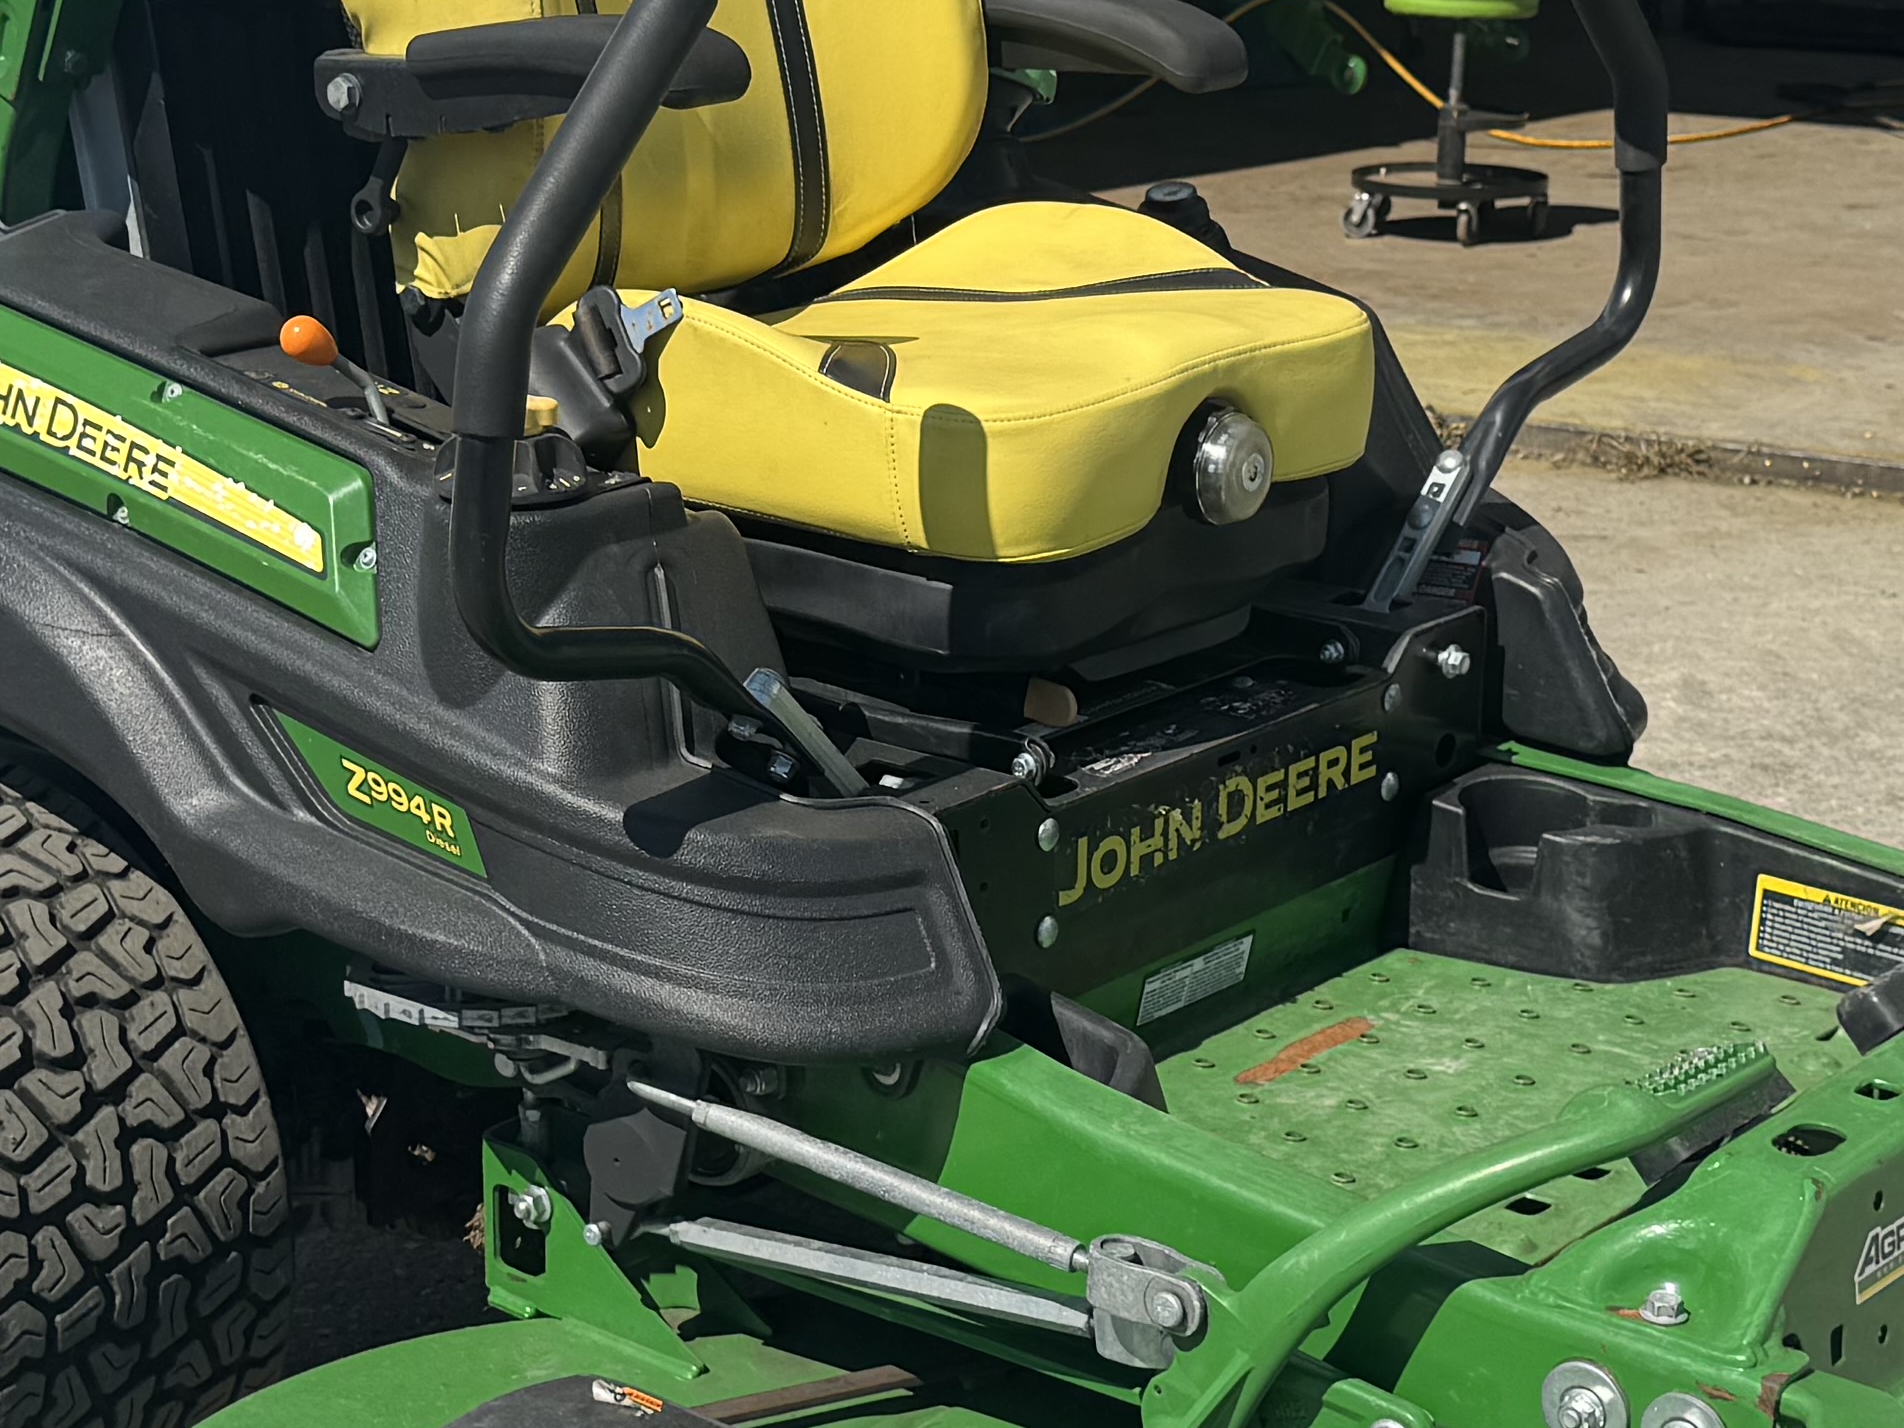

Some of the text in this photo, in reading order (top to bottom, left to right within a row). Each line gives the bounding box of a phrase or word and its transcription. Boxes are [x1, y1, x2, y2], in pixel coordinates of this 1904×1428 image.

[46, 395, 177, 493] DEERE
[340, 757, 456, 839] Z994R
[1058, 730, 1378, 907] JOHN DEERE
